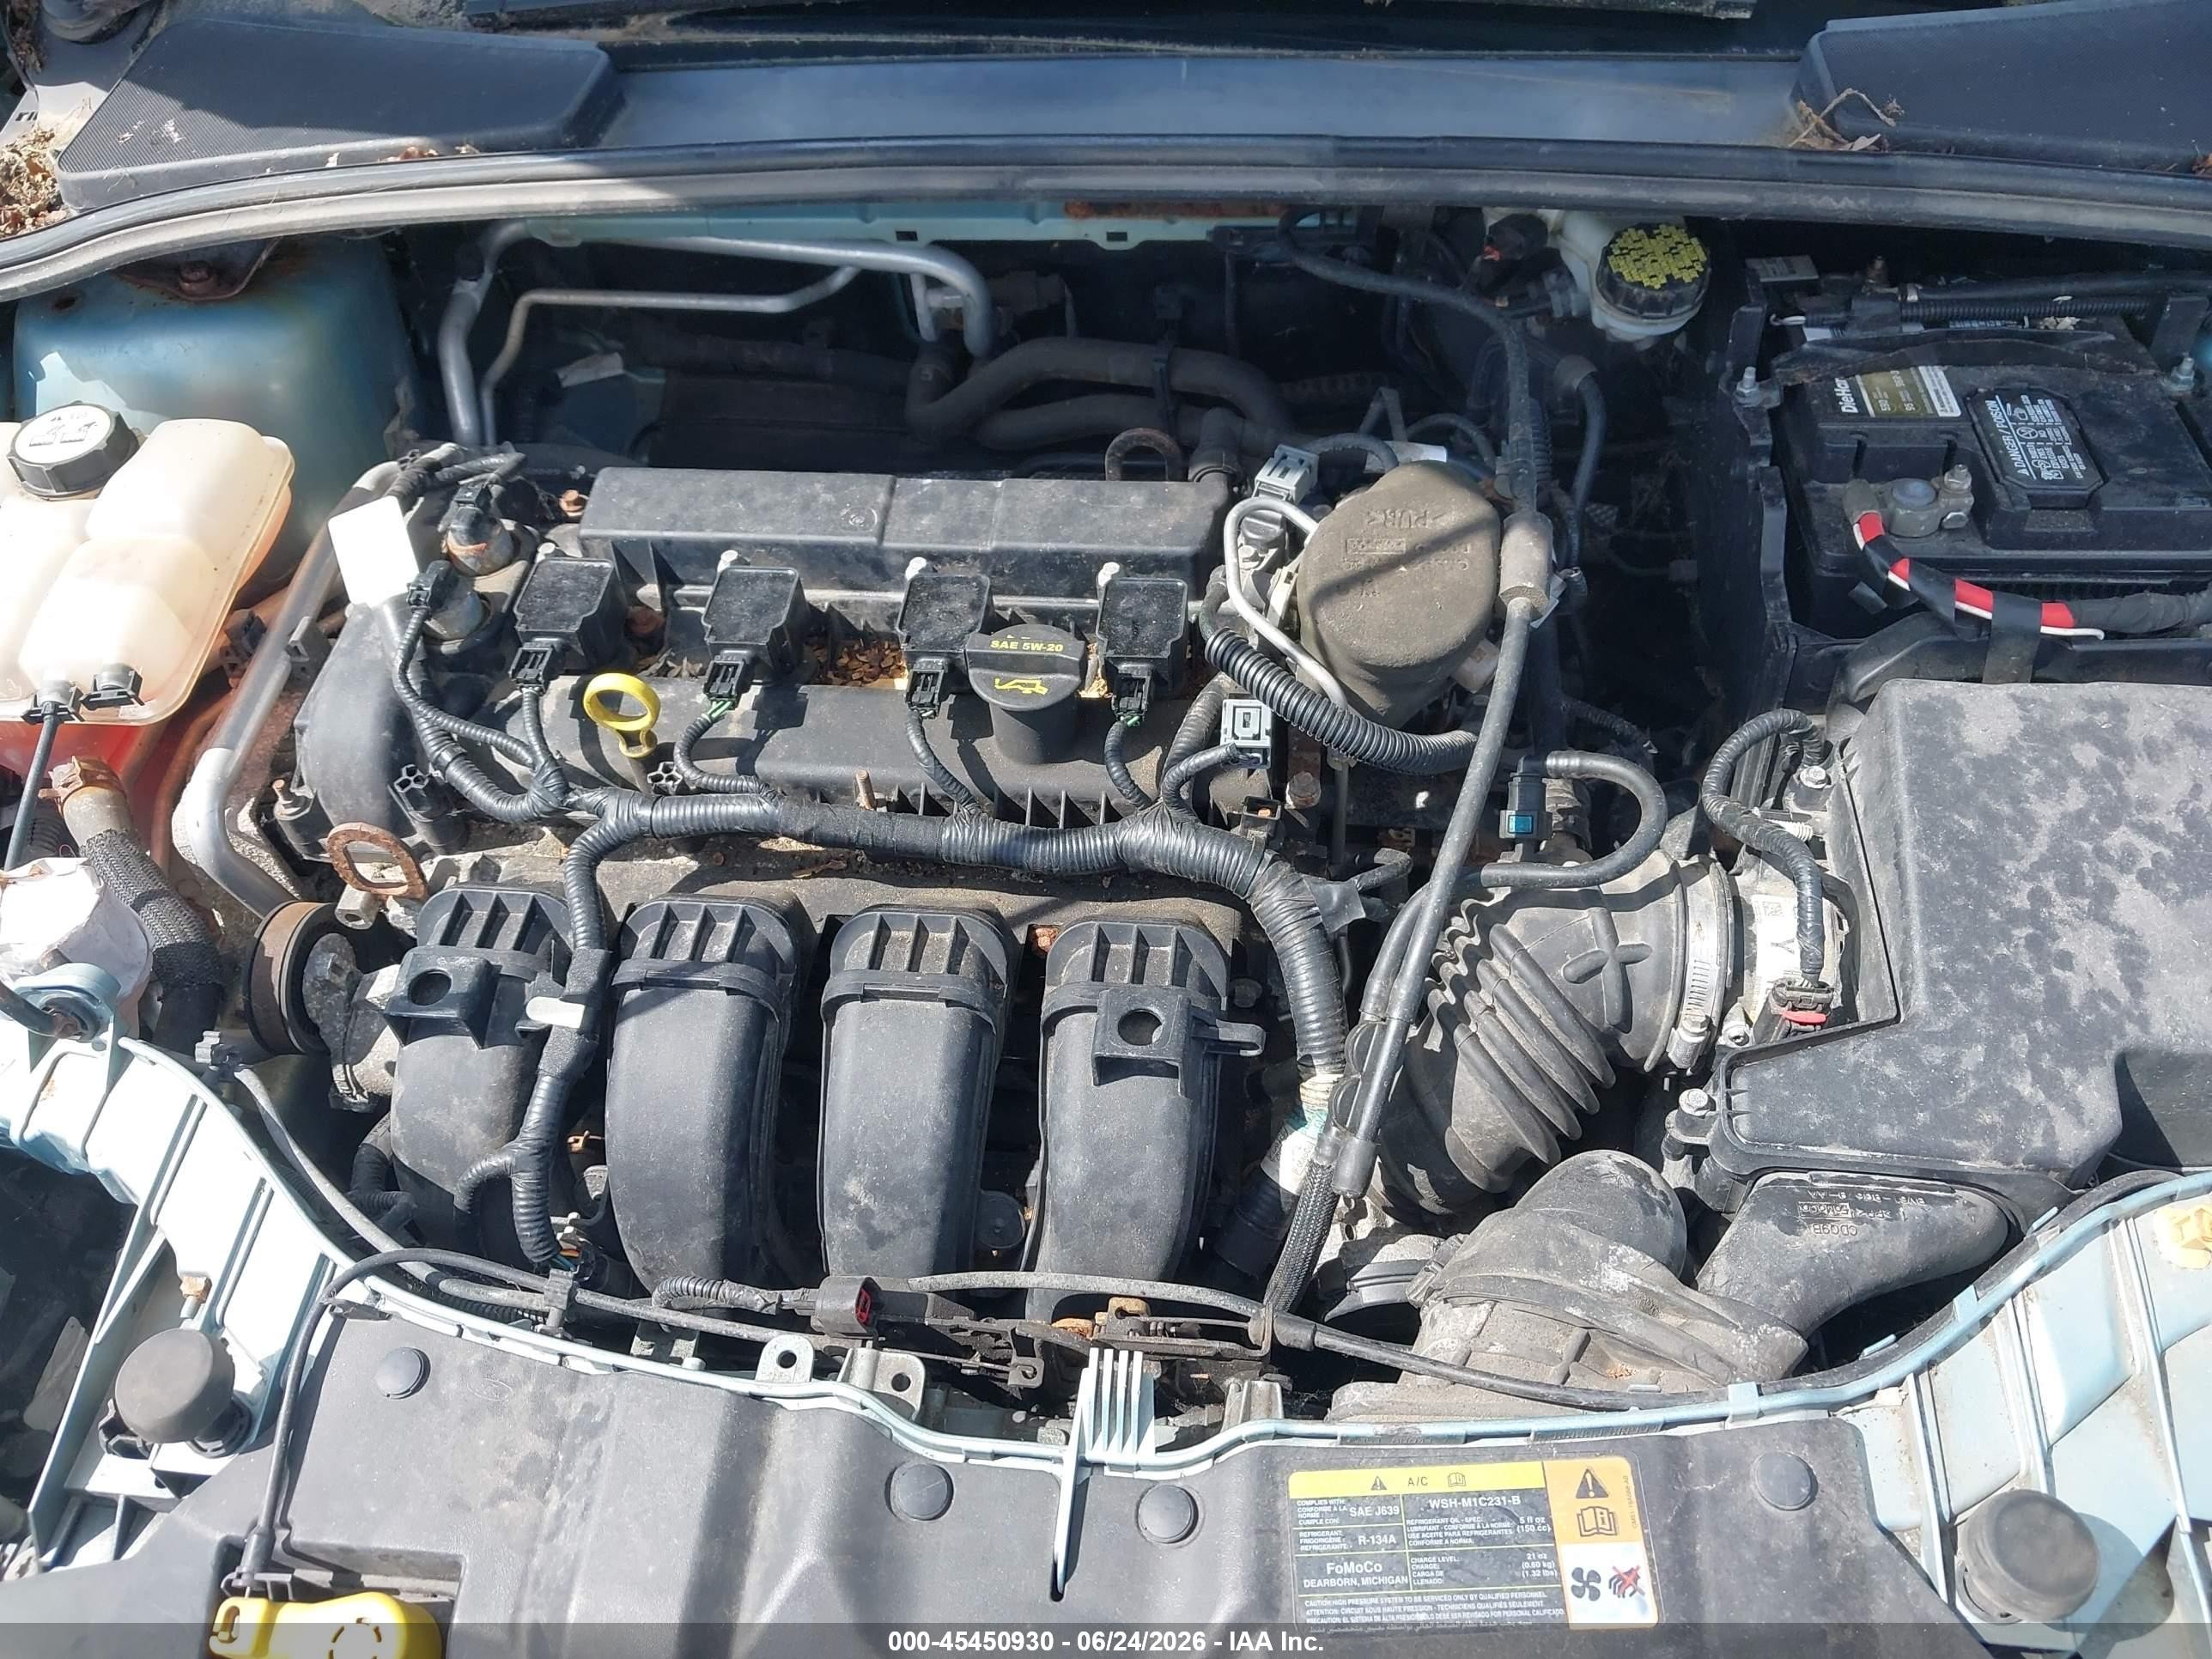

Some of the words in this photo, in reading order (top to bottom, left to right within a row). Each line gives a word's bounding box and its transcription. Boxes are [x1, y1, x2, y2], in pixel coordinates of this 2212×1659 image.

[1834, 378, 1859, 413] DieHar
[1985, 400, 2008, 428] POISON
[2002, 435, 2027, 468] DANGER
[990, 640, 1018, 649] SAE
[1022, 642, 1064, 652] 5W-20
[1407, 1476, 1428, 1487] A/C
[1429, 1496, 1522, 1510] WSH-M1C231-B
[1349, 1506, 1372, 1517] SAE
[1375, 1505, 1400, 1516] J639
[1516, 1524, 1536, 1534] (150
[1358, 1534, 1397, 1546] R-134A
[1408, 1538, 1443, 1547] CONFORME
[1326, 1560, 1383, 1575] FoMoCo
[1542, 1560, 1555, 1569] kg)
[1521, 1570, 1542, 1578] (1.32
[1542, 1569, 1558, 1577] lbs)
[1303, 1577, 1361, 1588] DEARBORN,
[1361, 1575, 1408, 1586] MICHIGAN
[1347, 1597, 1379, 1606] PRESSURE
